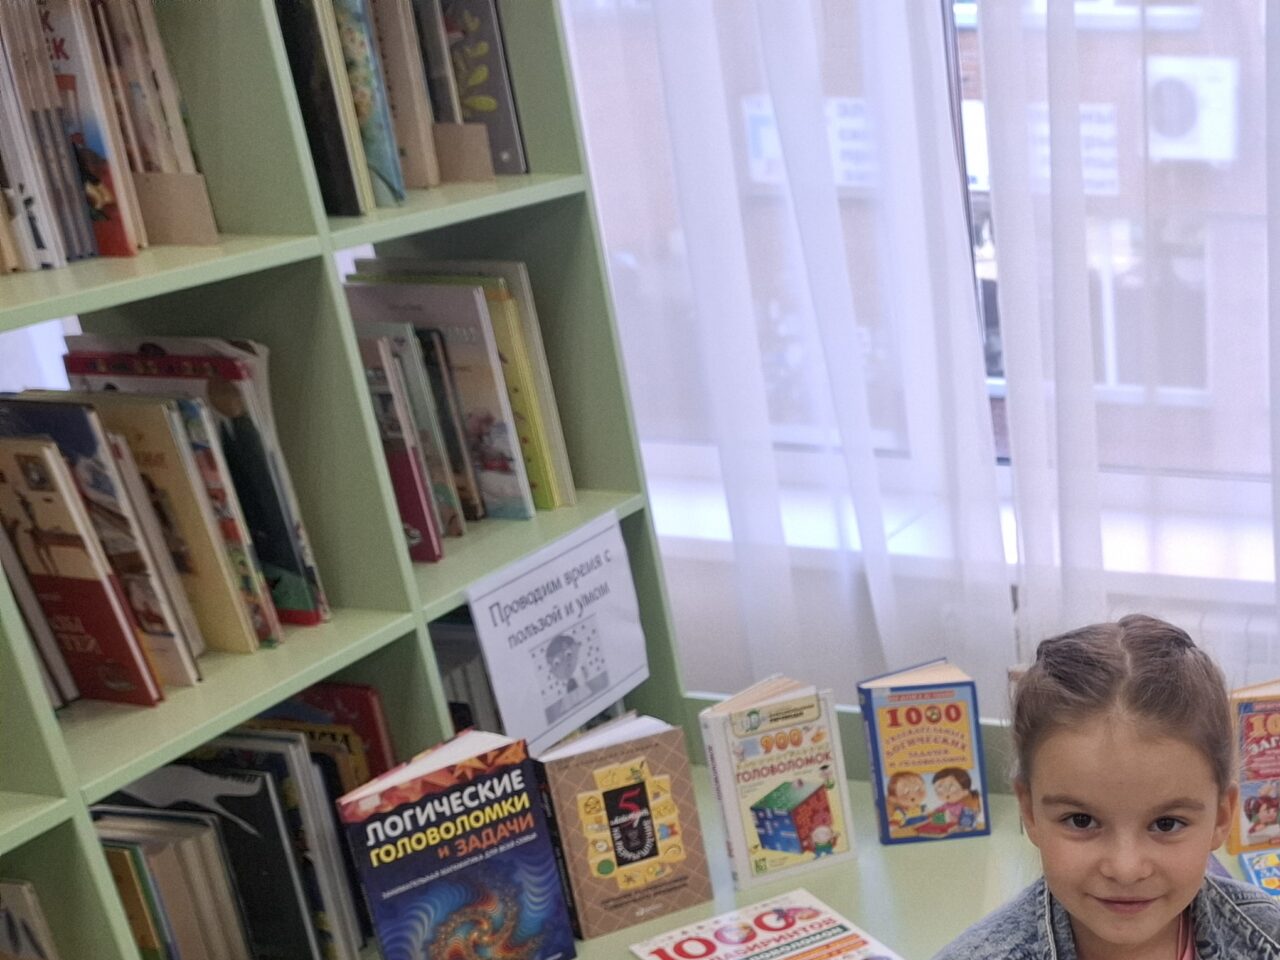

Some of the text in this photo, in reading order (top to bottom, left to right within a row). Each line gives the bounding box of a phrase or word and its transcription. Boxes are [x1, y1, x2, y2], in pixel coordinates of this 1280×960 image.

[489, 549, 612, 627] Проводим время с
[508, 582, 610, 648] пользой и умом
[887, 704, 962, 728] 1000
[365, 769, 525, 846] ЛОГИЧЕСКИЕ
[370, 792, 530, 868] ГОЛОВОЛОМКИ
[455, 812, 535, 858] ЗАДАЧИ
